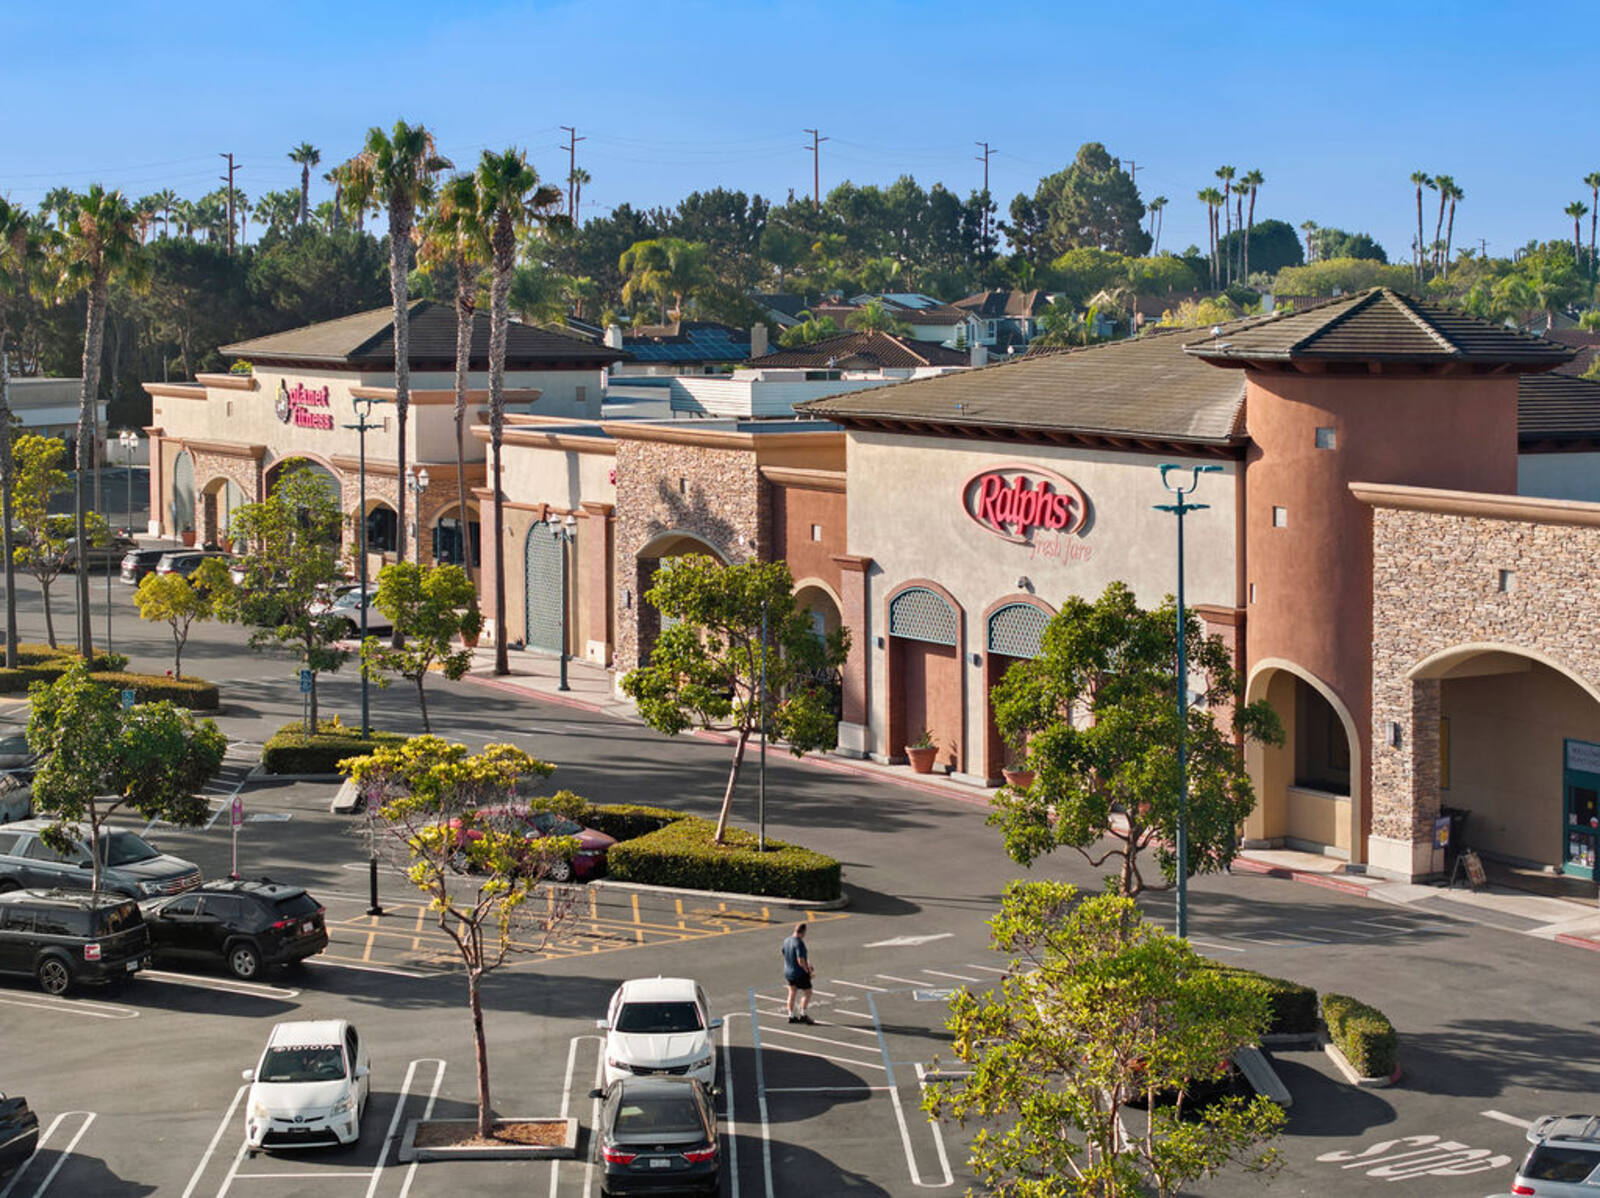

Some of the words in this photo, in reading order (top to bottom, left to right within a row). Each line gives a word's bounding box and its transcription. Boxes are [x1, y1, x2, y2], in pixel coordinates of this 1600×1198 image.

[289, 382, 330, 409] planet
[293, 406, 334, 431] fitness
[976, 473, 1073, 536] Ralphs
[1029, 532, 1062, 561] fresh
[1061, 536, 1093, 566] fare
[285, 1044, 335, 1052] TOYOTA
[1316, 1135, 1513, 1182] STOP
